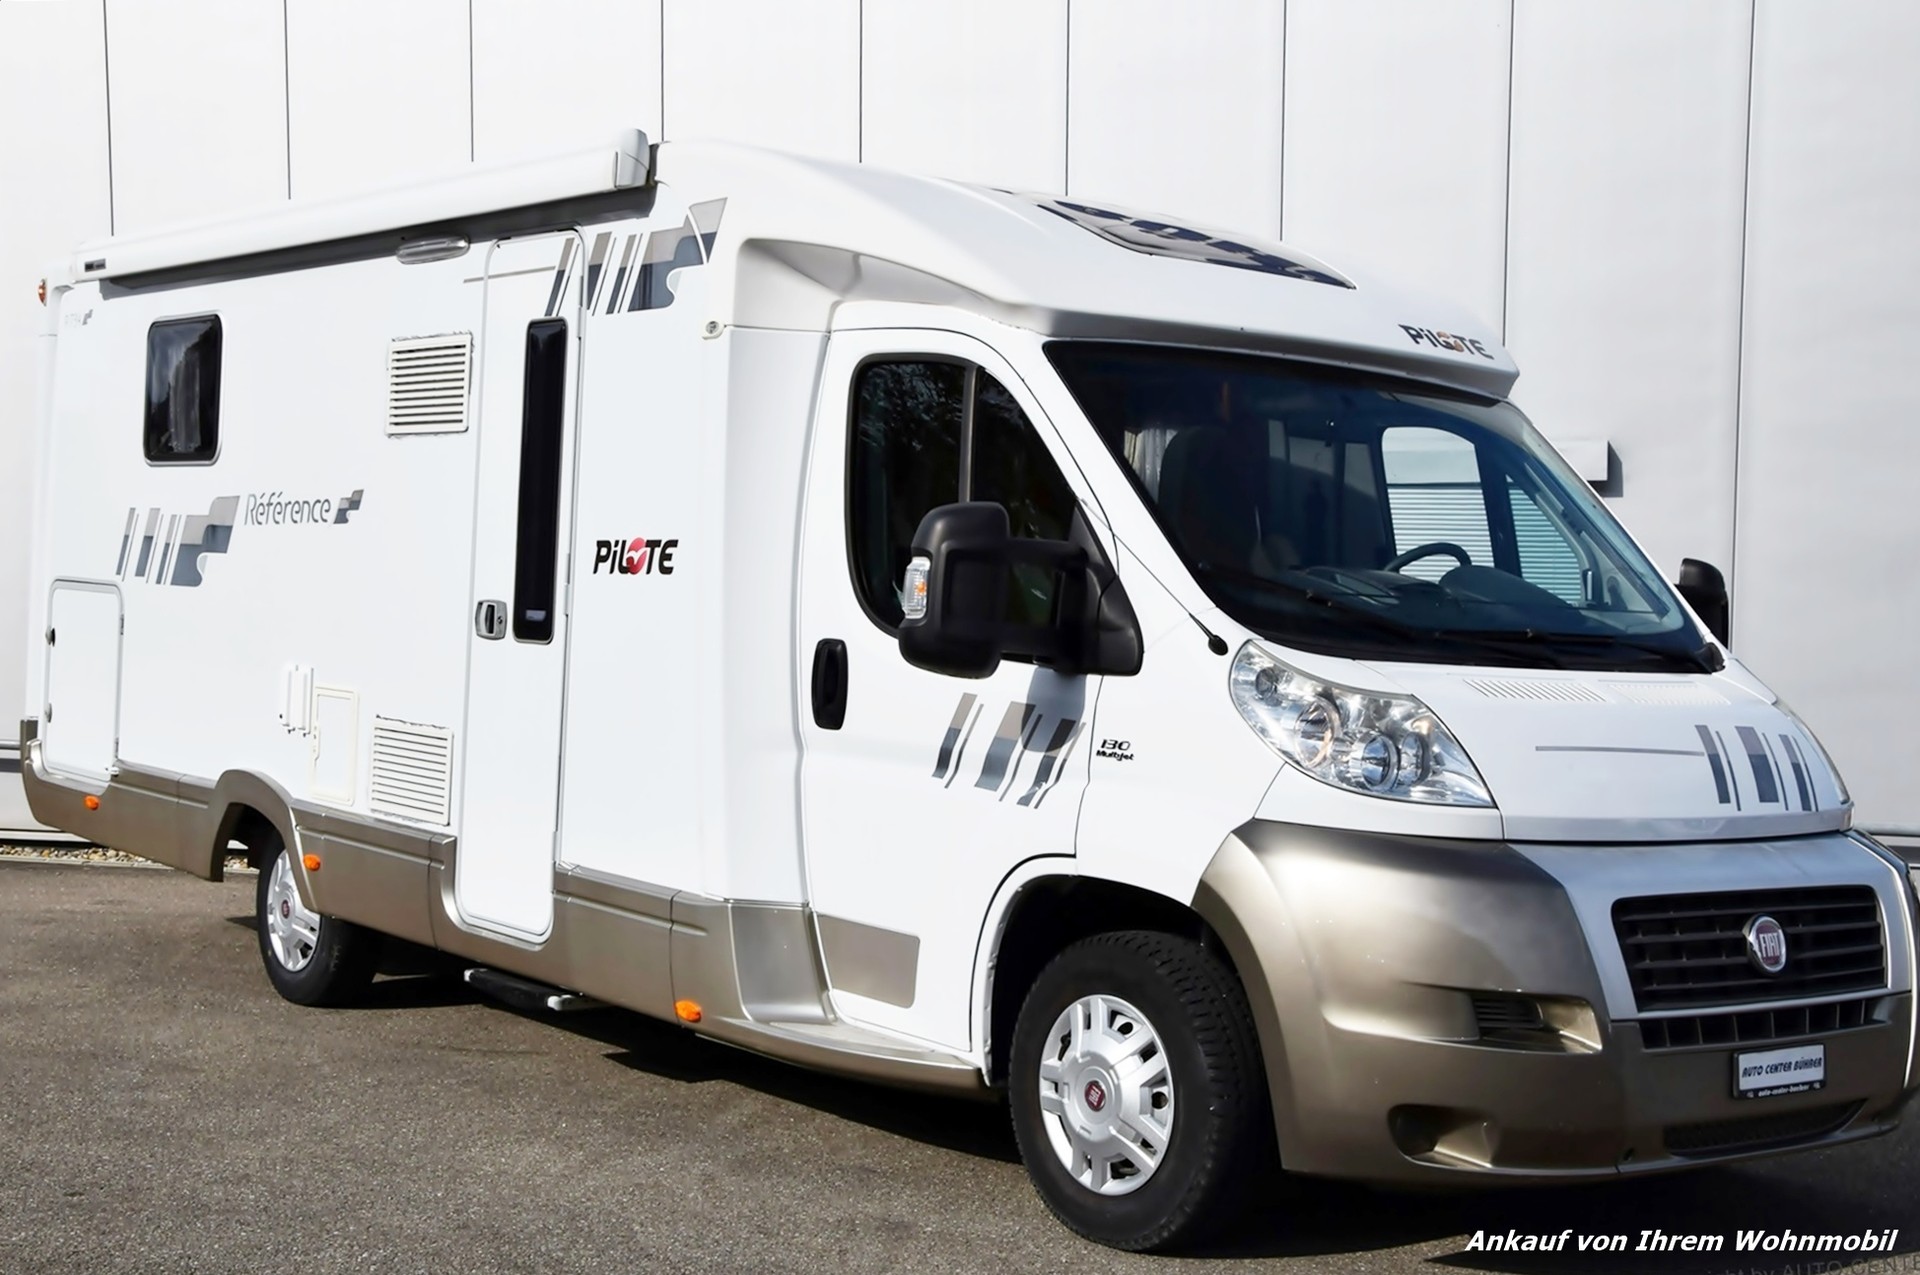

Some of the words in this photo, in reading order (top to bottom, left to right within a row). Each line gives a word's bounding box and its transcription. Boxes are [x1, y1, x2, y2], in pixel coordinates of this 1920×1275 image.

[244, 491, 331, 525] Référence
[1101, 738, 1131, 751] 130
[1759, 932, 1781, 957] FIAT
[1742, 1065, 1764, 1078] AUTO
[1765, 1060, 1793, 1075] CENTER
